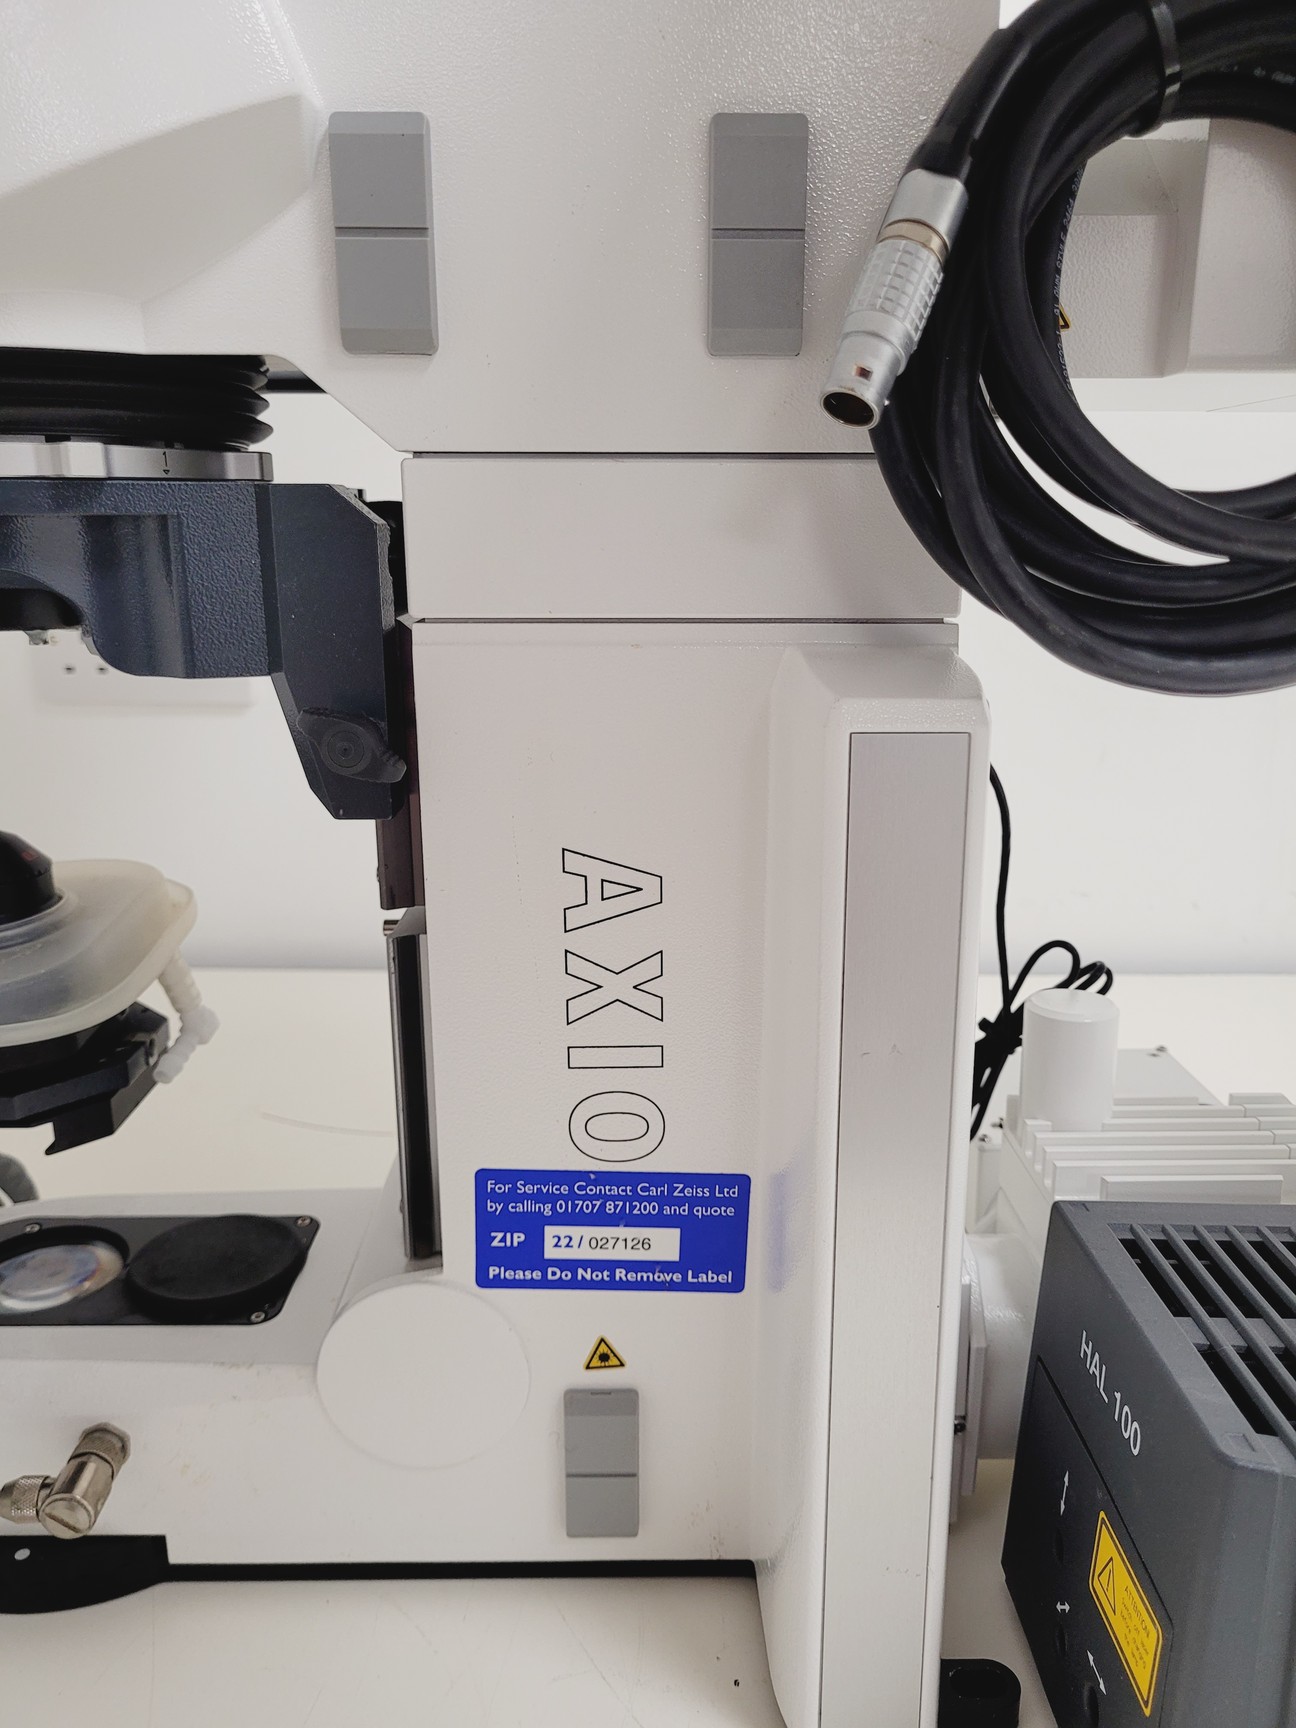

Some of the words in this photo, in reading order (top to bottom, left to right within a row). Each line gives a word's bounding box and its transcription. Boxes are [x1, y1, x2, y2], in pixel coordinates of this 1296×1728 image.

[162, 451, 168, 468] 1
[562, 847, 665, 1162] AXIO
[487, 1180, 512, 1194] For
[516, 1181, 569, 1195] Service
[574, 1182, 633, 1196] Contact
[637, 1183, 668, 1197] Carl
[673, 1183, 710, 1198] Zeiss
[715, 1185, 739, 1198] Ltd
[487, 1199, 504, 1216] by
[508, 1200, 552, 1217] calling
[556, 1200, 601, 1214] 01707
[605, 1201, 659, 1215] 871200
[663, 1202, 689, 1216] and
[693, 1205, 735, 1219] quote
[490, 1232, 526, 1248] ZIP
[488, 1266, 542, 1280] Please
[547, 1267, 572, 1281] Do
[577, 1267, 610, 1281] Not
[615, 1268, 682, 1283] Remove
[687, 1269, 732, 1284] Label
[1080, 1329, 1109, 1404] HAL
[1114, 1391, 1141, 1456] 100
[1124, 1585, 1150, 1639] ATTENTION
